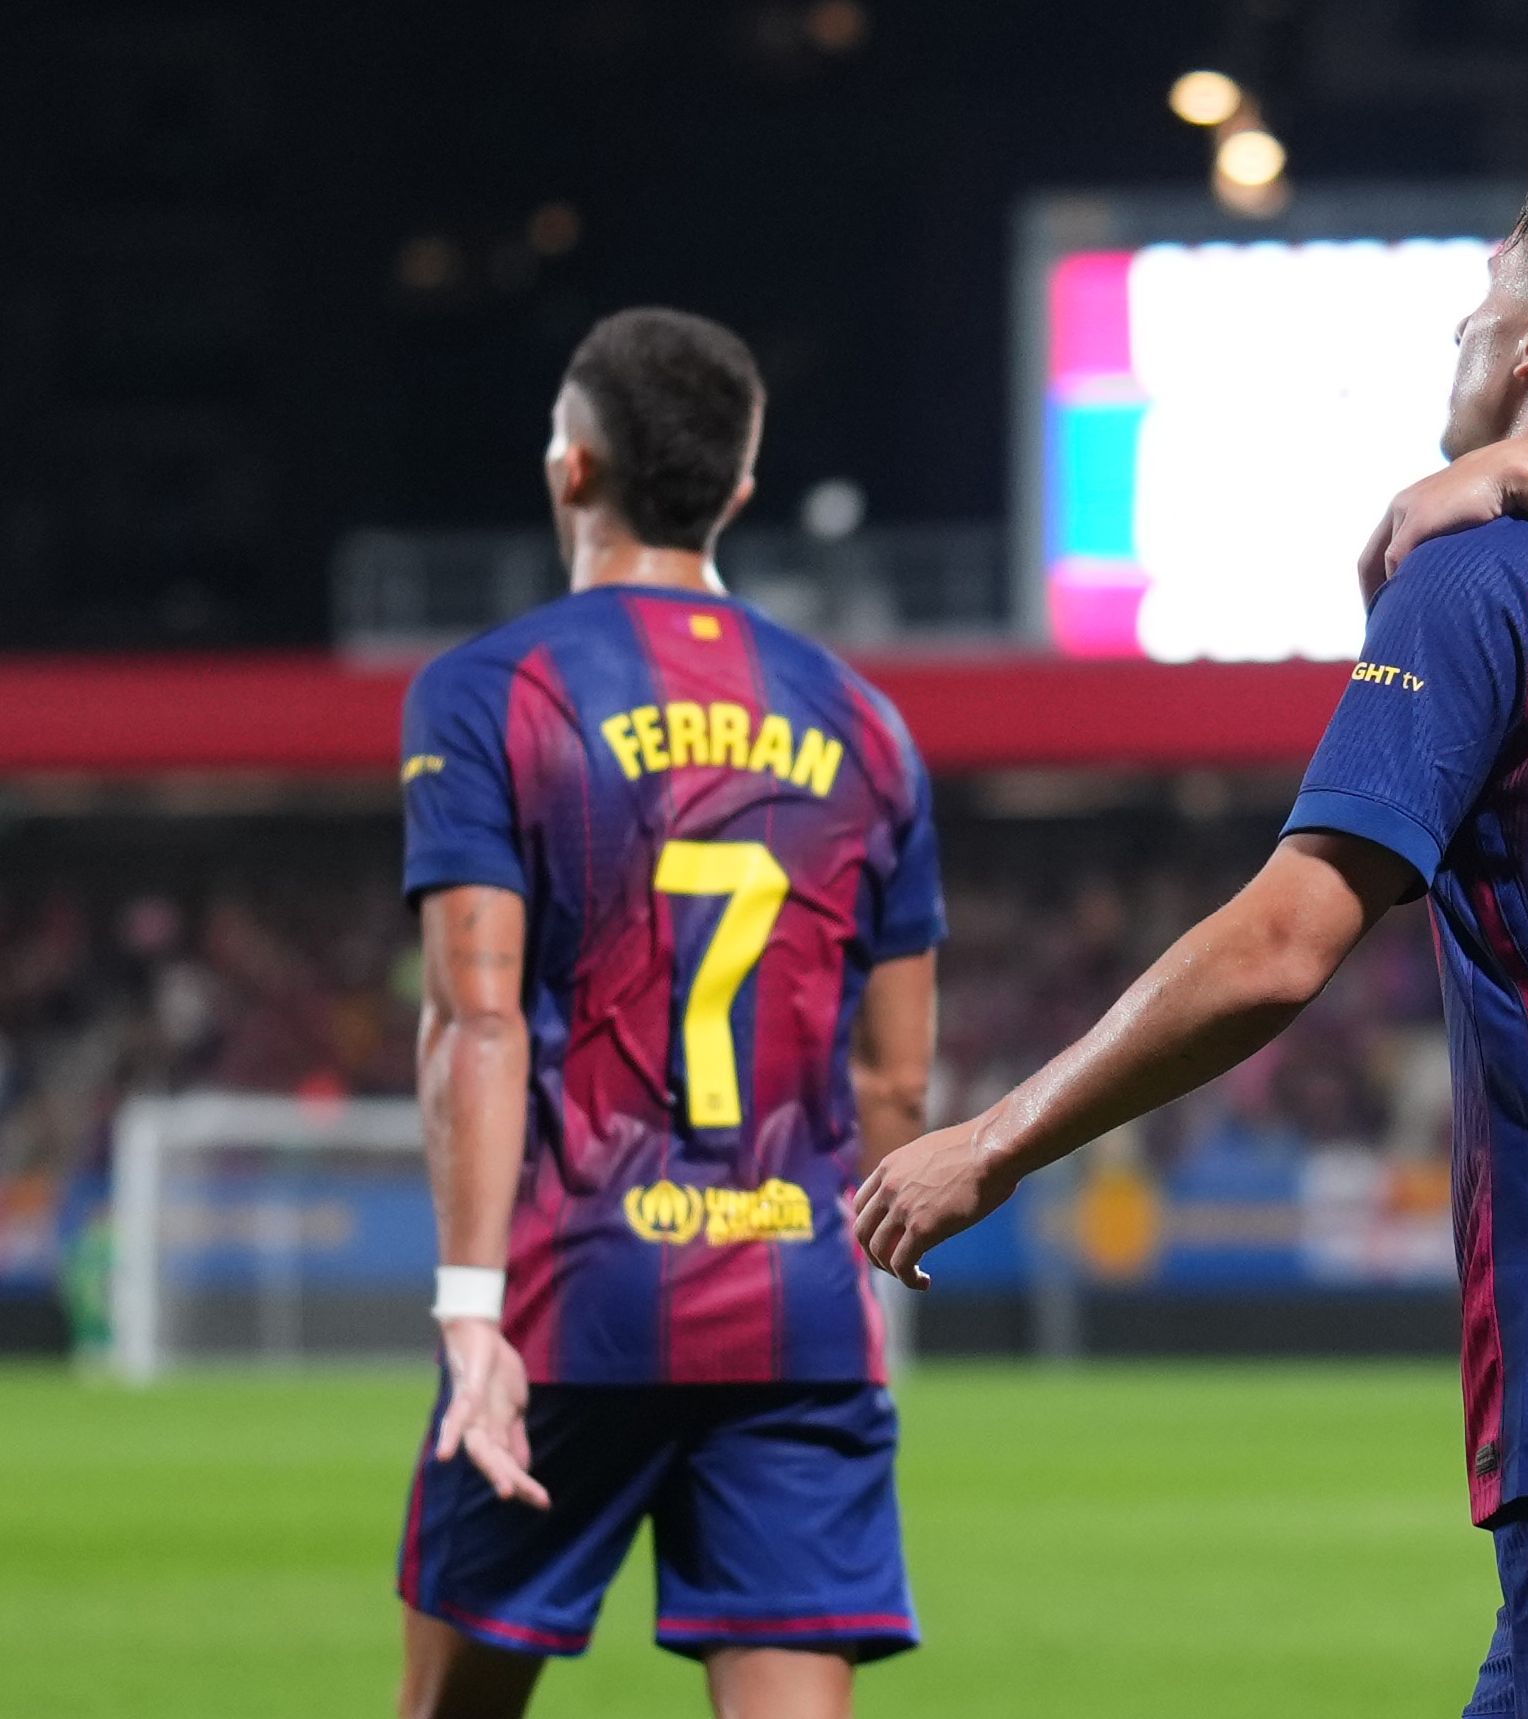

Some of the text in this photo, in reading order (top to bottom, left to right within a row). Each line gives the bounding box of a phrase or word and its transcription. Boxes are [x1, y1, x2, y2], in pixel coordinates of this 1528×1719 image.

[1402, 672, 1424, 692] tv
[600, 701, 844, 798] FERRAN
[654, 840, 790, 1128] 7
